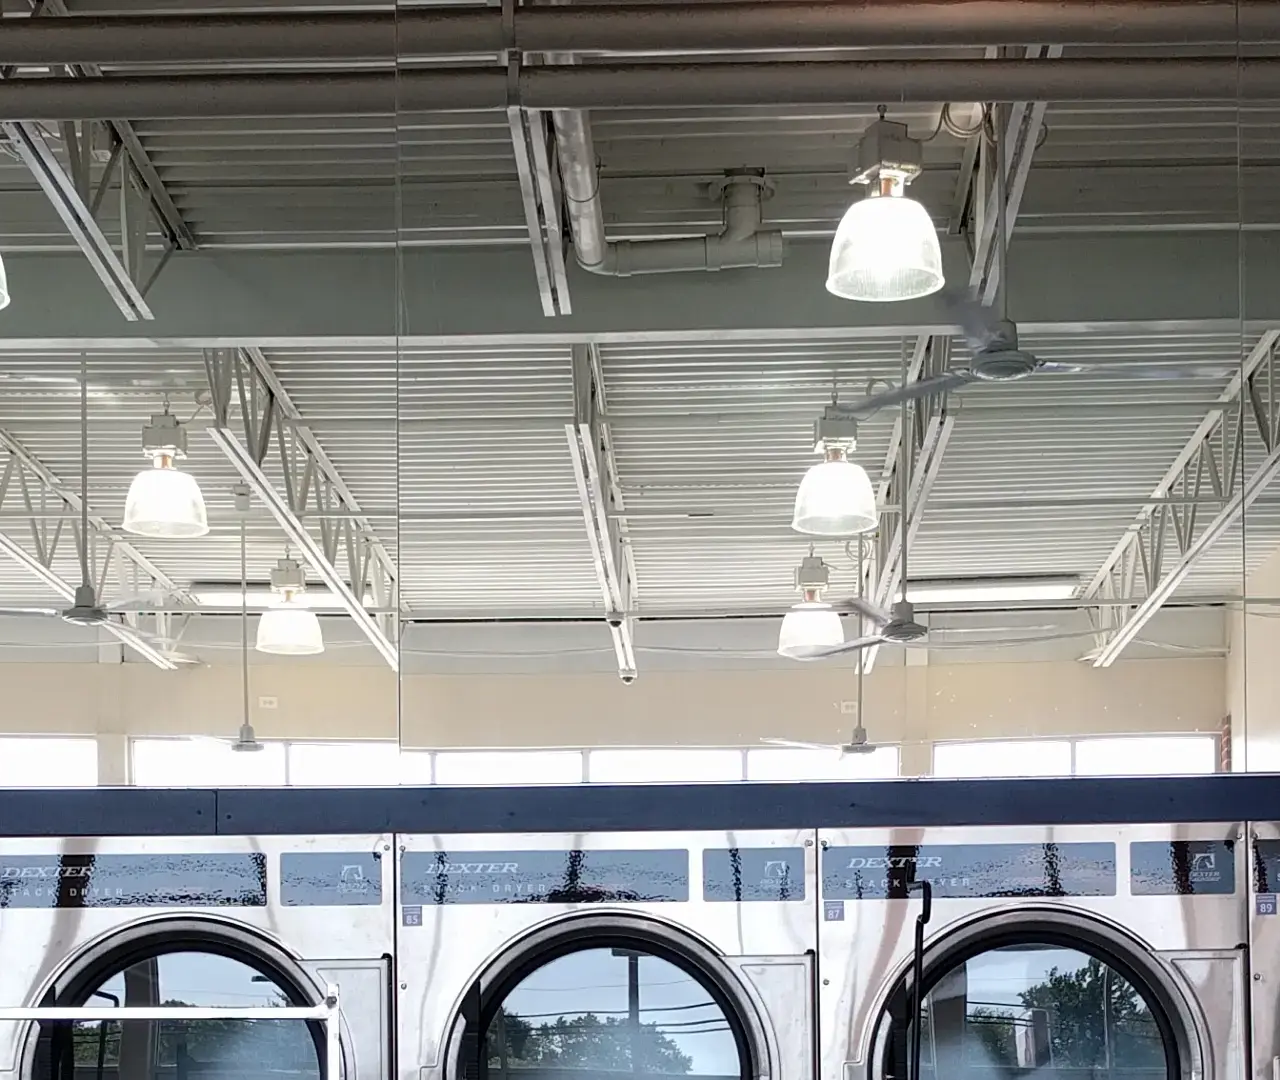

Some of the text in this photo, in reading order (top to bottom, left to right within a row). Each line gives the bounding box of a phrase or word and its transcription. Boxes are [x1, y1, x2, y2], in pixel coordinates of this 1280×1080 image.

[846, 856, 942, 869] DEXTER
[1, 866, 95, 878] DEXTER
[425, 862, 519, 874] DEXTER
[845, 878, 901, 888] STACK
[1, 887, 56, 897] TACK
[423, 883, 547, 894] SACK DRYER
[1260, 903, 1273, 913] 89
[406, 915, 418, 924] 85
[828, 910, 840, 919] 87
